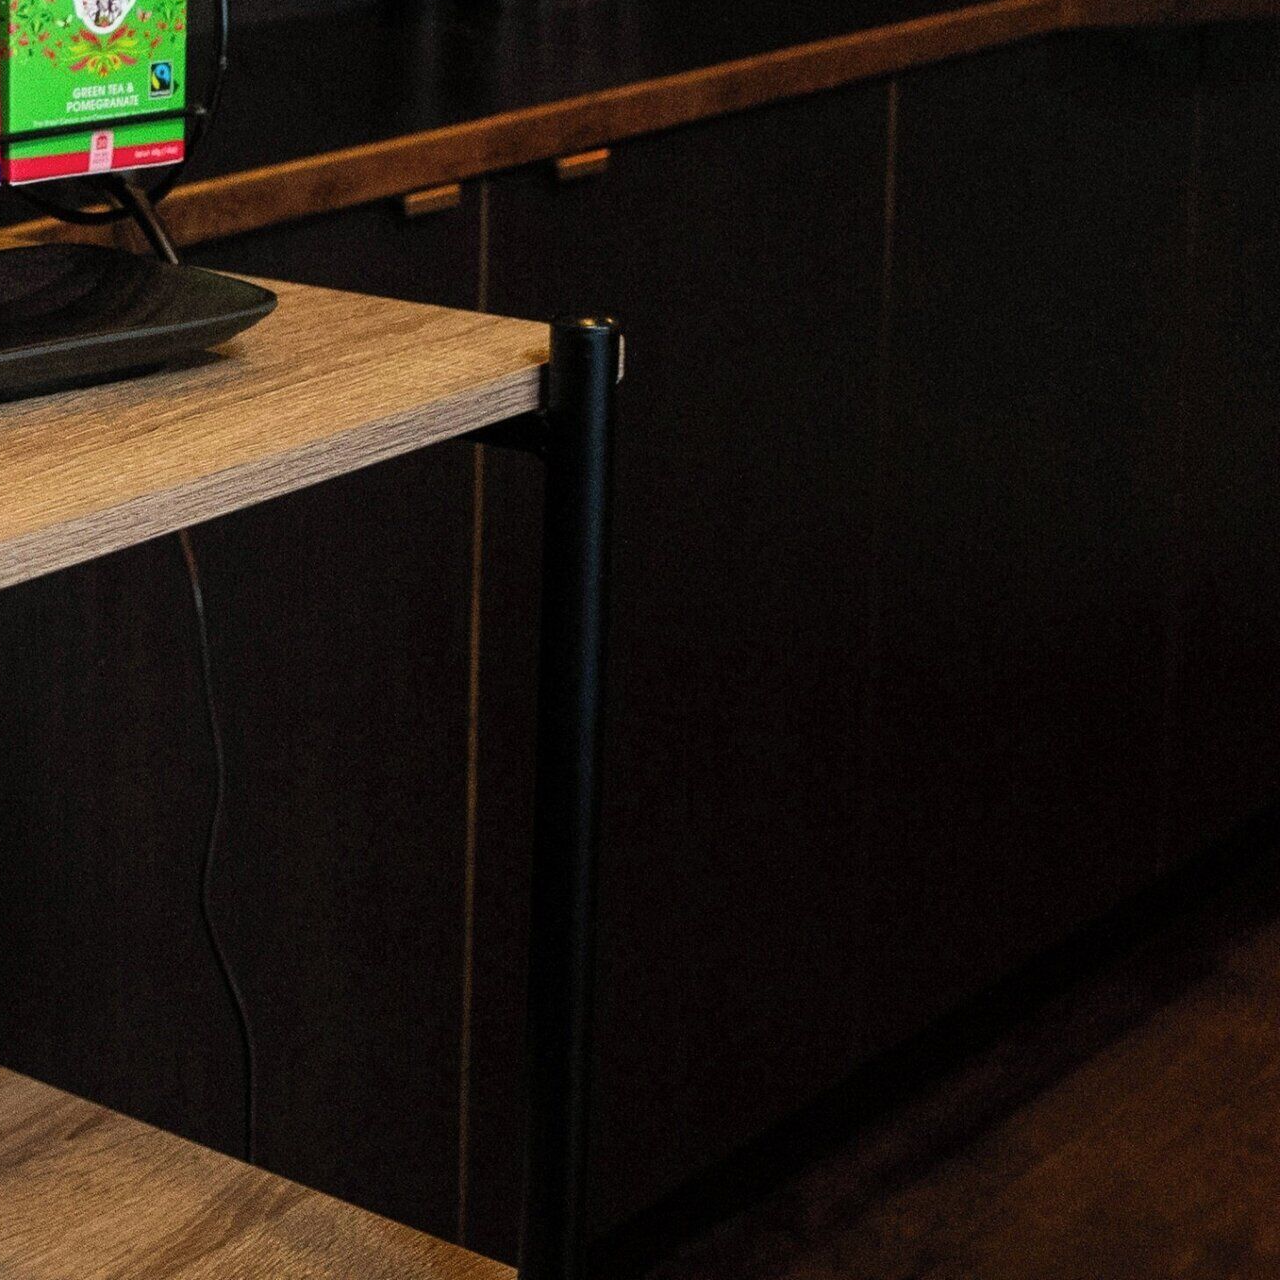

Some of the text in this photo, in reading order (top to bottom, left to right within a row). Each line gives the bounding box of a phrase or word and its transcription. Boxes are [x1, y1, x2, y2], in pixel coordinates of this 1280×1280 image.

[73, 86, 105, 99] GREEN
[107, 84, 124, 96] TEA
[66, 95, 139, 113] POMEGRANATE
